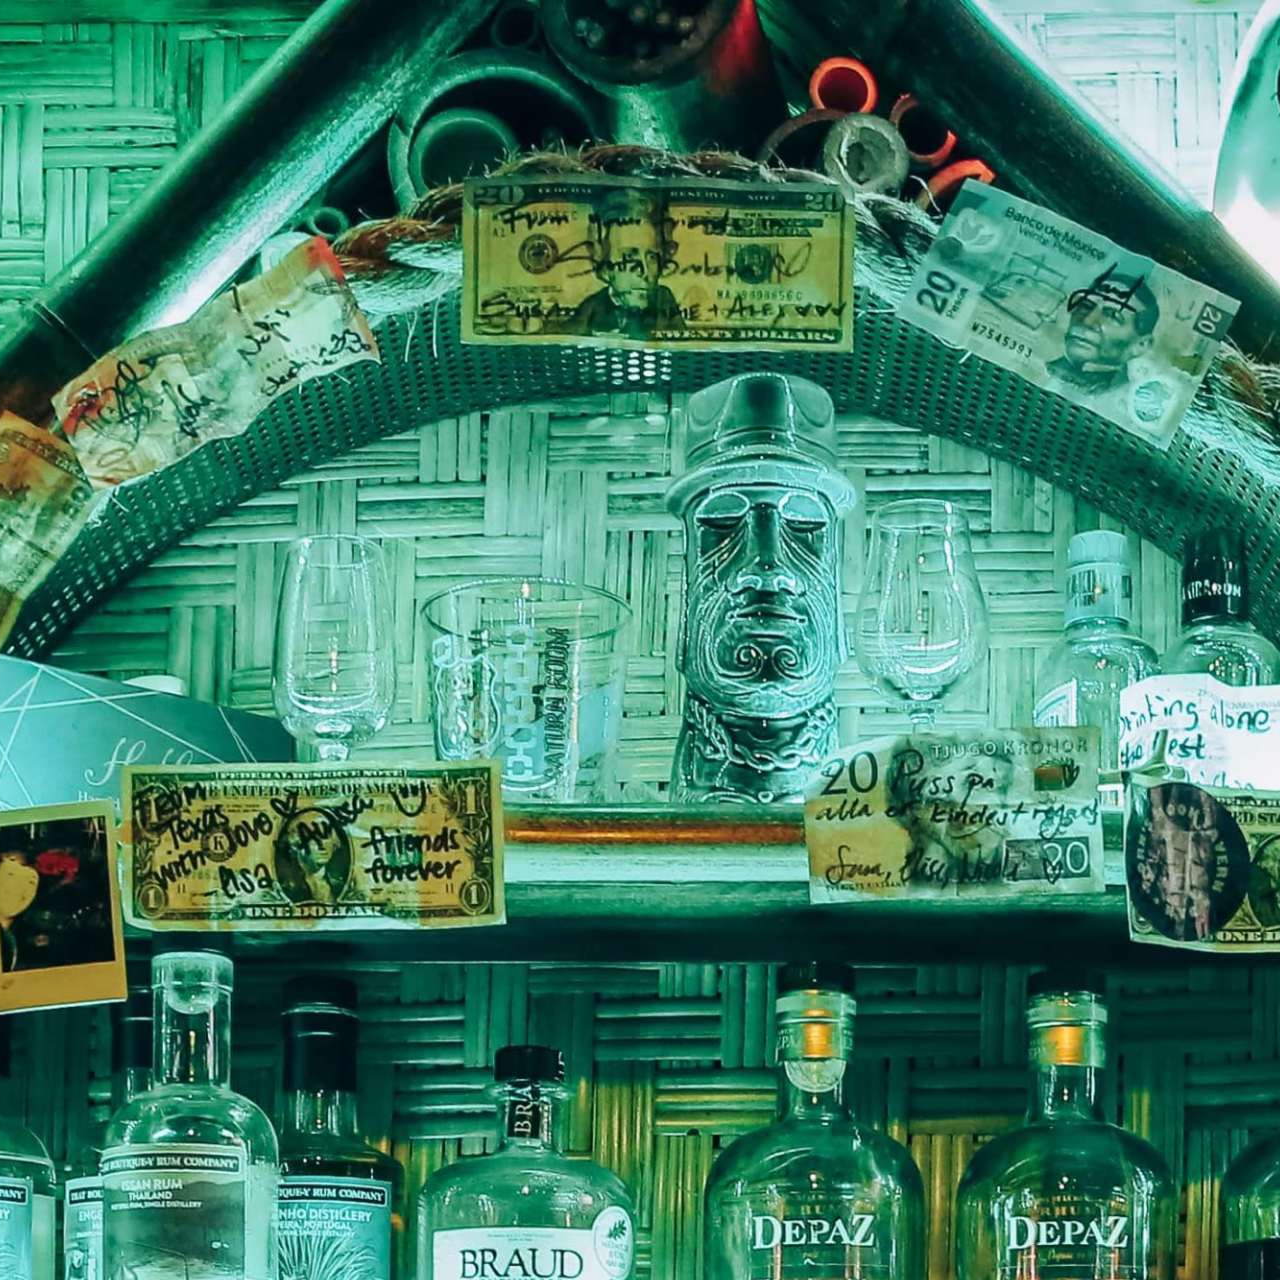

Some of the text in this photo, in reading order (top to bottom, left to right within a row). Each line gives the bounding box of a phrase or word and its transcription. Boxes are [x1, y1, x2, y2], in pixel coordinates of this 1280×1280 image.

[916, 270, 957, 315] 20
[1201, 306, 1224, 336] 20
[931, 742, 997, 759] TJUGO
[821, 752, 879, 795] 20
[224, 783, 280, 797] UNITED
[169, 802, 231, 850] Texas
[362, 825, 461, 852] friends
[365, 860, 461, 883] forever
[157, 1156, 181, 1167] RUM
[183, 1157, 238, 1169] COMPANY
[128, 1191, 173, 1200] THAILAND
[154, 1178, 183, 1190] RUM
[312, 1188, 383, 1201] RUM COMPANY
[309, 1209, 373, 1222] DISTILLERY
[752, 1214, 875, 1250] DEPAZ
[1006, 1215, 1129, 1250] DEPAZ
[460, 1249, 584, 1280] BRAUD
